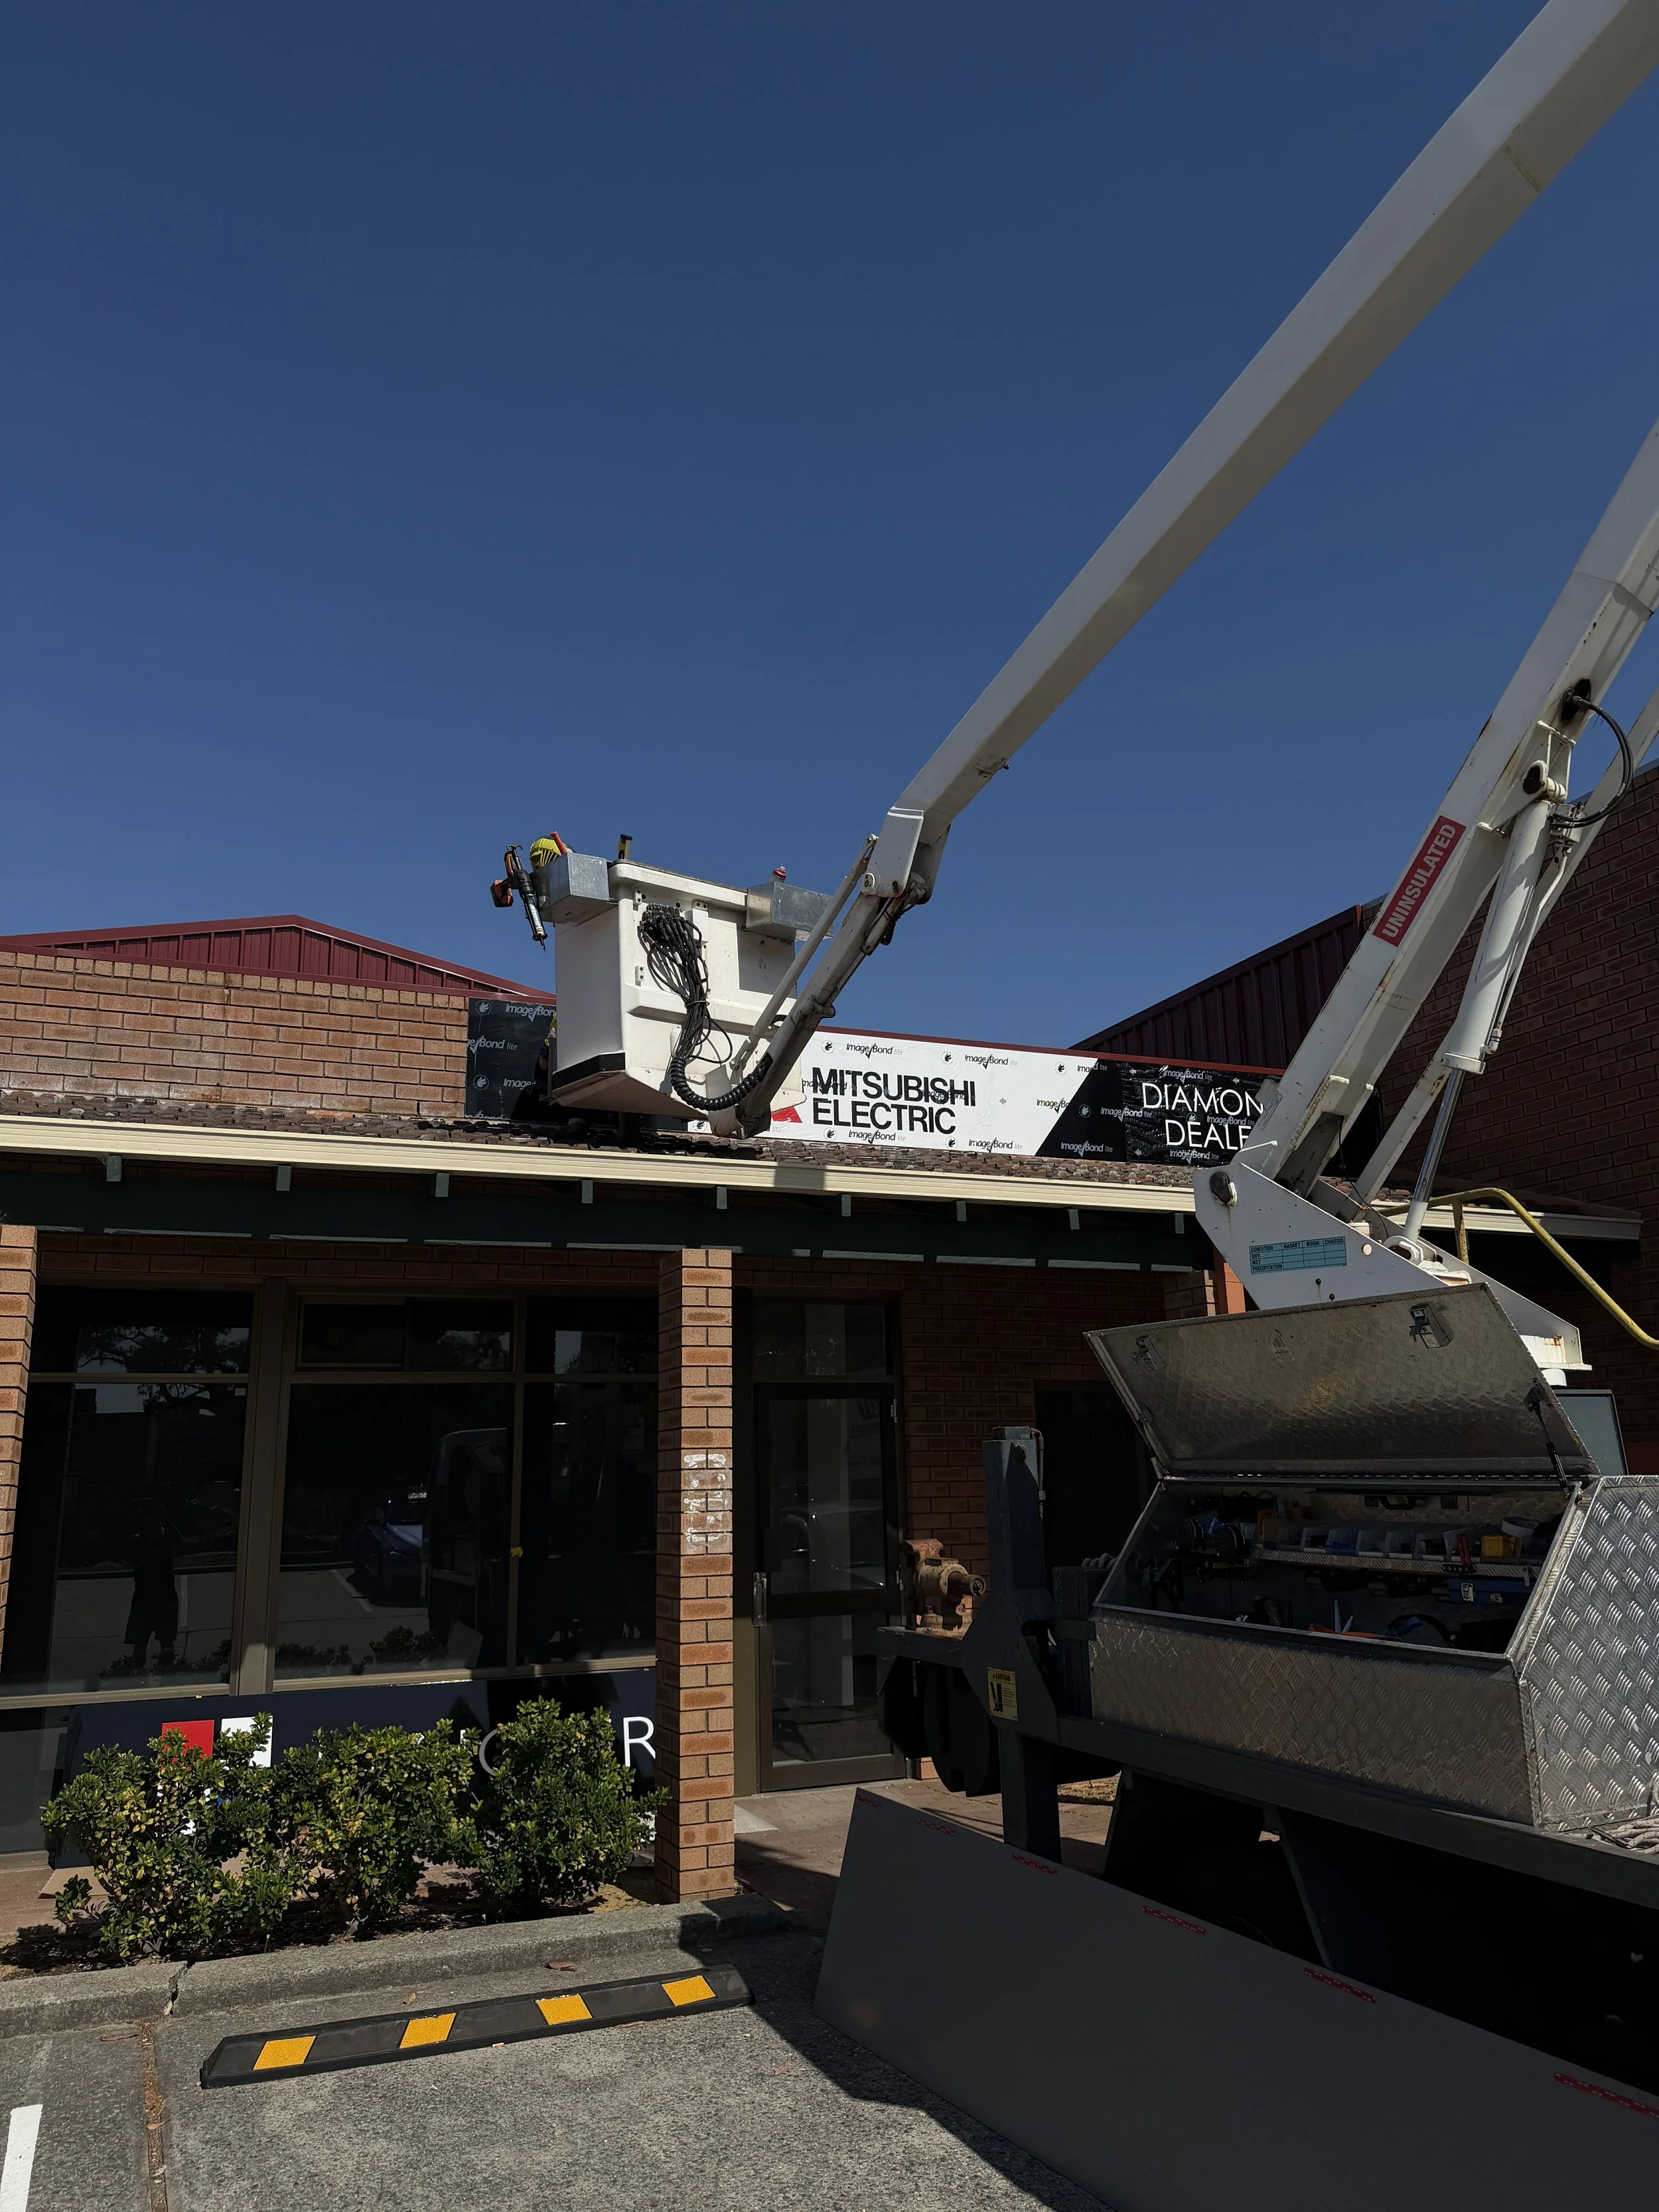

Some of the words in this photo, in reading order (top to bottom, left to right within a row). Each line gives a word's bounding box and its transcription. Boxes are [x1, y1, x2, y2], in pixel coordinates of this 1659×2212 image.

[1382, 824, 1456, 937] UNINSULATED
[812, 1067, 976, 1106] MITSUBISHI
[813, 1097, 956, 1135] ELECTRIC
[897, 1133, 906, 1142] lite
